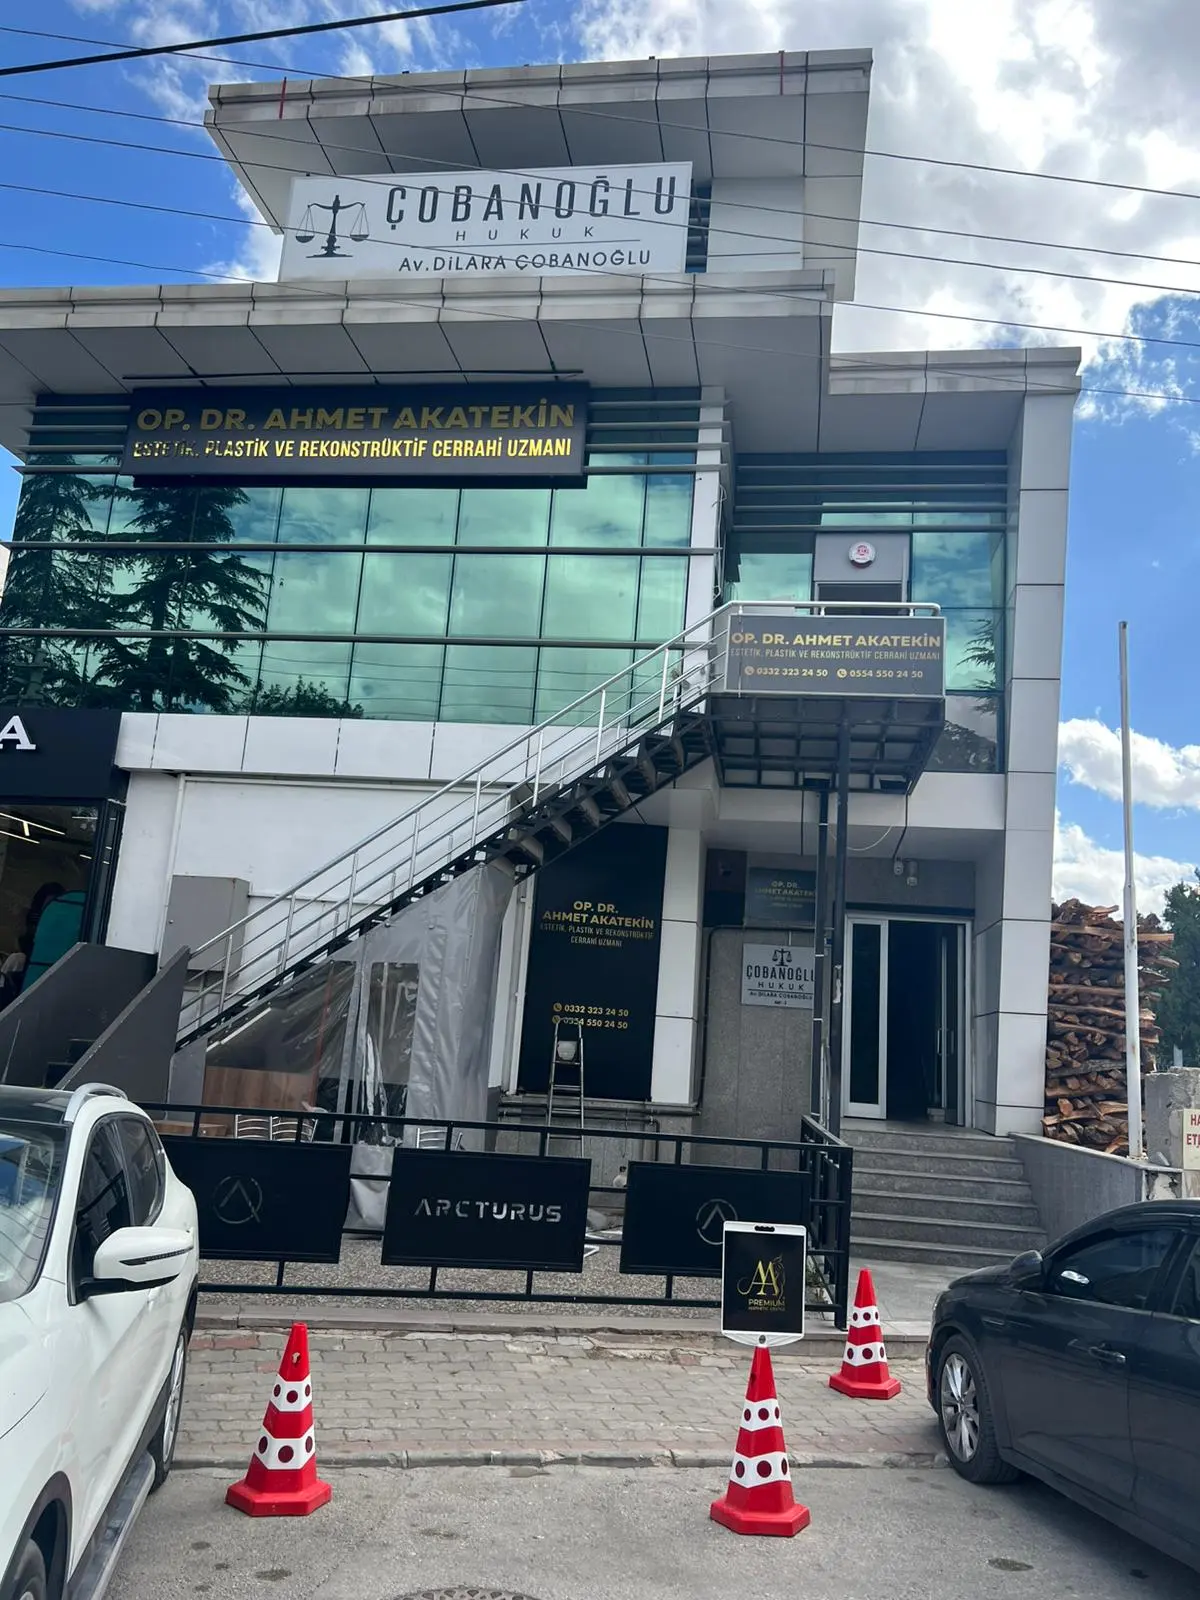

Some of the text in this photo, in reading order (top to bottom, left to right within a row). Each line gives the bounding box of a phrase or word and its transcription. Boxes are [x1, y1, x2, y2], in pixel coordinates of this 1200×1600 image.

[385, 175, 676, 230] ÇOBANOĞLU
[455, 226, 595, 241] HUKUK
[515, 249, 651, 271] ÇOBANOĞLU
[136, 397, 575, 432] OP. DR. AHMET AKATEKİN
[205, 437, 269, 457] PLASTİK
[274, 440, 295, 457] VE
[299, 437, 427, 458] REKONSTRÜKTİF
[432, 436, 502, 457] CERRAHİ
[507, 438, 571, 456] UZMANI
[731, 633, 941, 647] OP. DR. AHMET AKATEKİN
[799, 650, 809, 658] VE
[757, 667, 828, 678] 0332 323 24 50
[850, 669, 923, 680] 0554 550 24 50
[573, 901, 618, 914] OP. DR.
[542, 911, 654, 928] AHMET AKATEKİN
[758, 981, 804, 991] HUKUK
[564, 1004, 629, 1017] 0332 323 24 50
[586, 1018, 602, 1027] 550
[604, 1020, 615, 1029] 24
[617, 1020, 628, 1029] 50
[1186, 1133, 1200, 1148] ET
[414, 1198, 562, 1223] ARCTURUS
